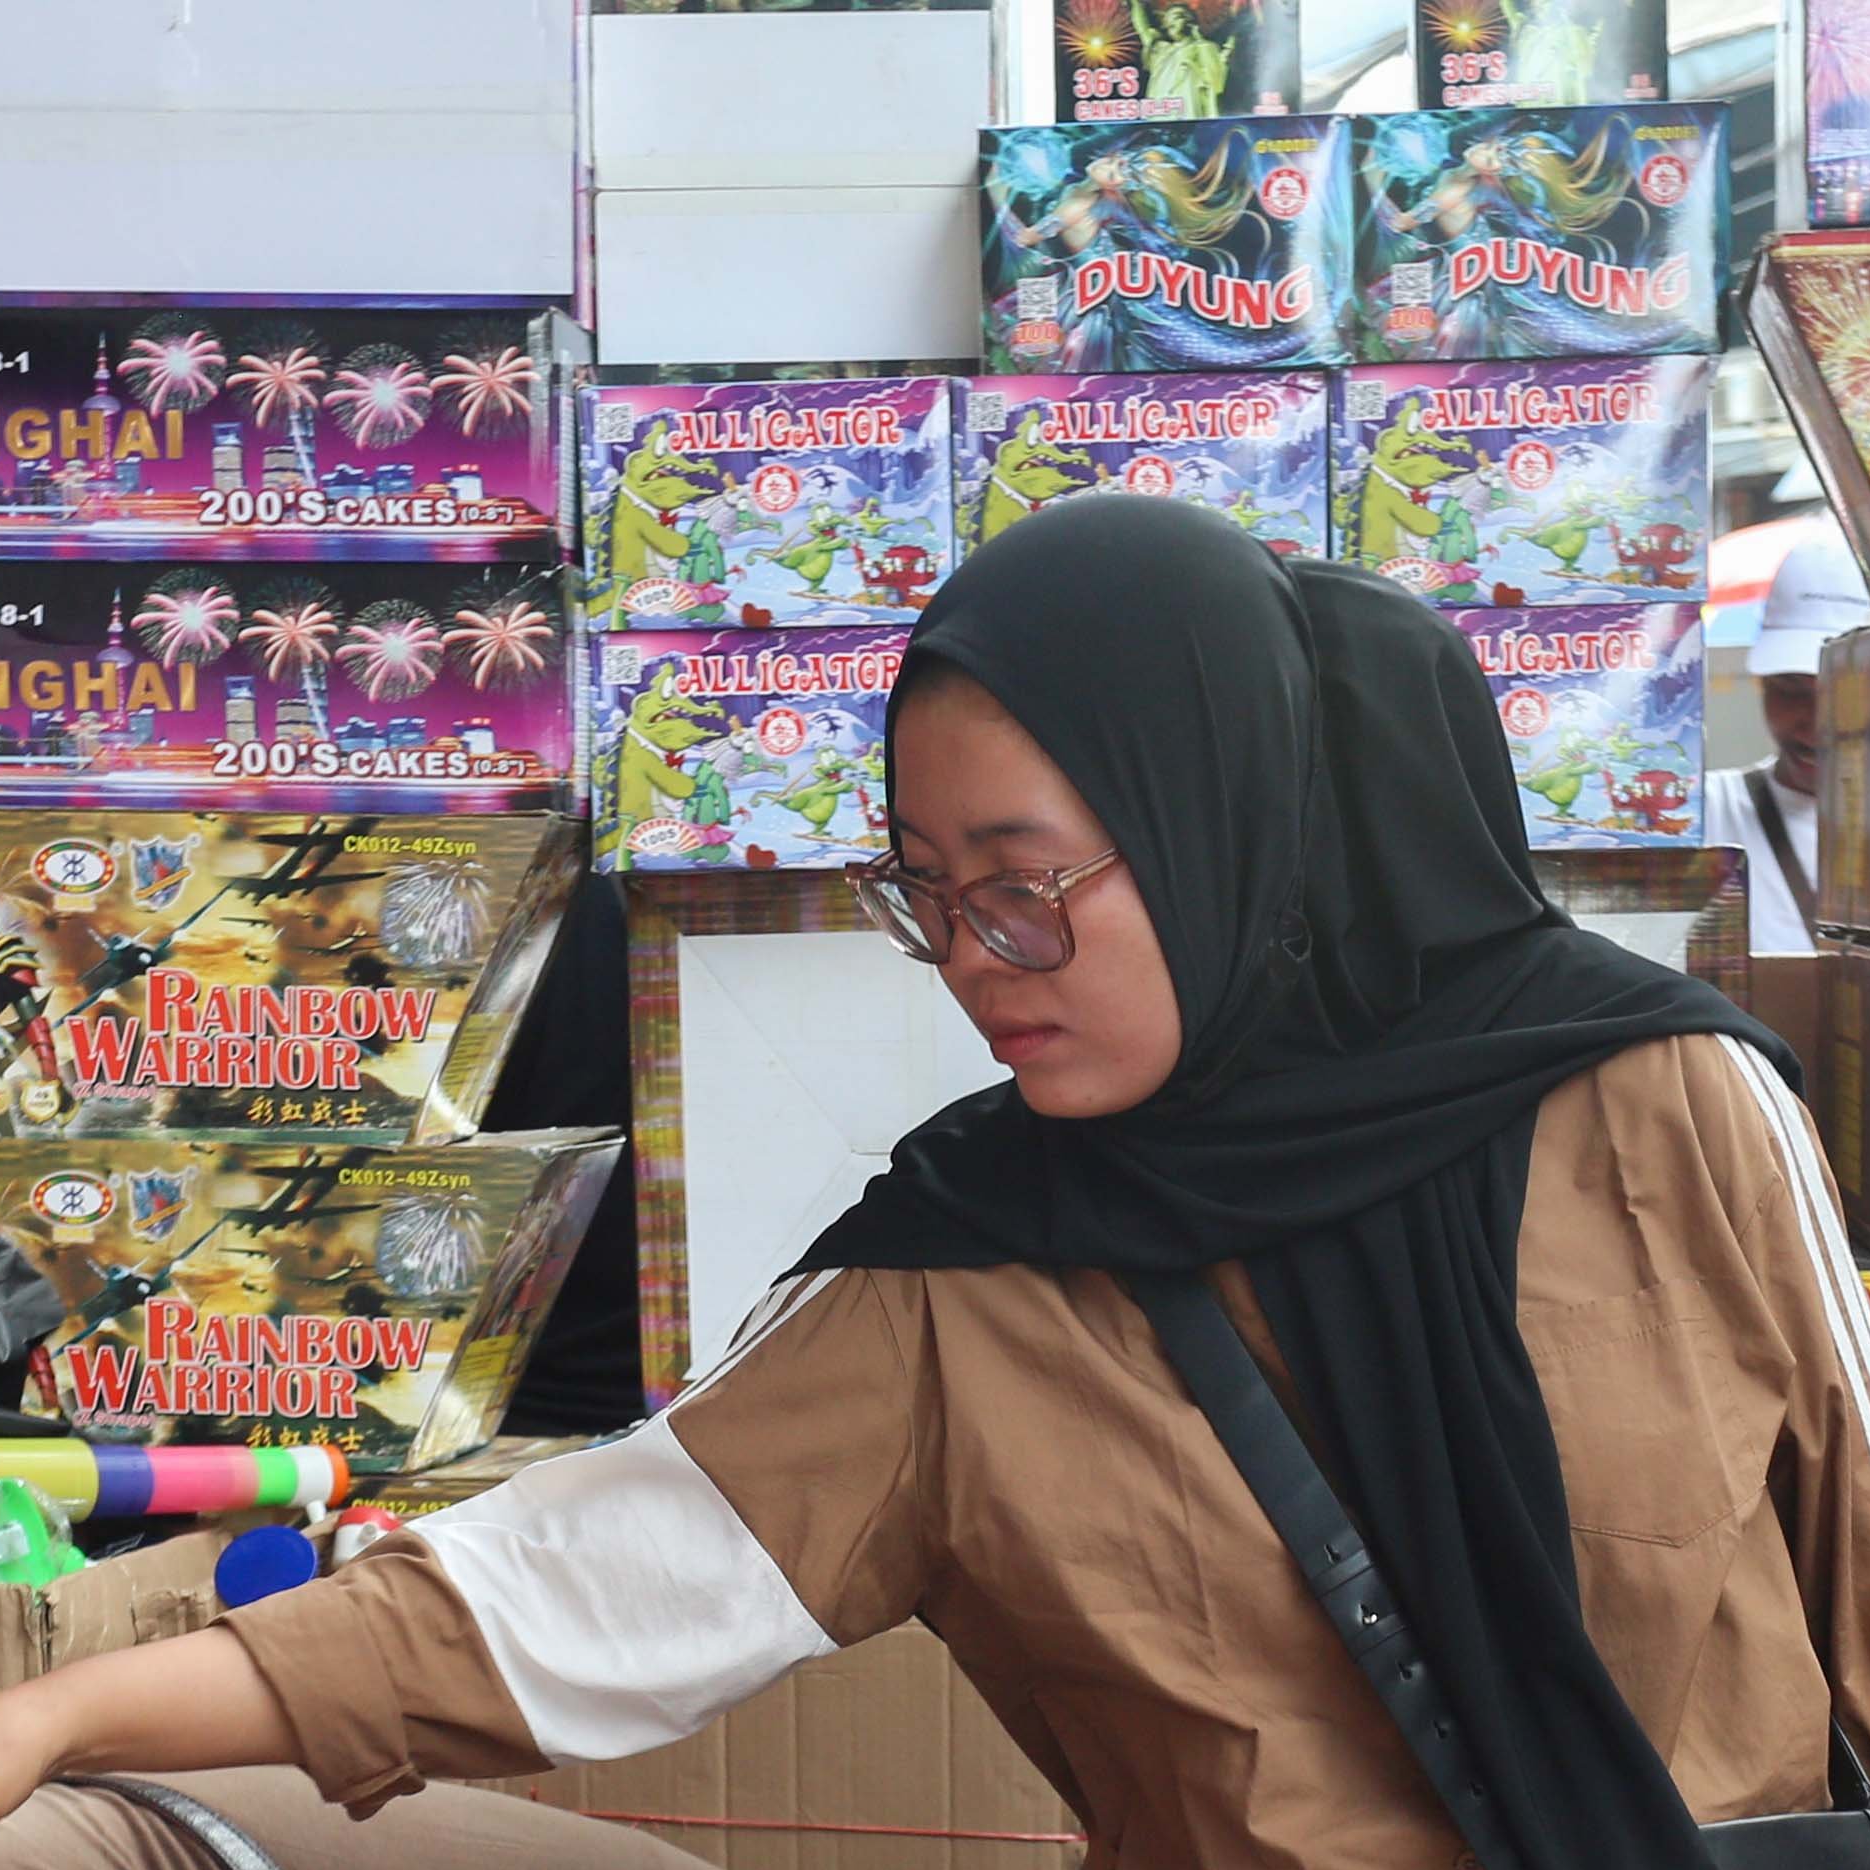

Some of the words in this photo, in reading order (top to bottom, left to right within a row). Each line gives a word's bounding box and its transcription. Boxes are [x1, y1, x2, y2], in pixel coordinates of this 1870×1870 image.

[1075, 252, 1312, 328] DUYUNG
[1451, 238, 1690, 315] DUYUNG
[198, 488, 327, 525] 200'S
[333, 498, 458, 525] CAKES
[213, 741, 339, 778] 200'S
[340, 751, 469, 778] CAKES
[145, 965, 434, 1043] RAINBOW
[66, 1015, 362, 1091] WARRIOR
[144, 1297, 431, 1369] RAINBOW
[64, 1344, 357, 1419] WARRIOR
